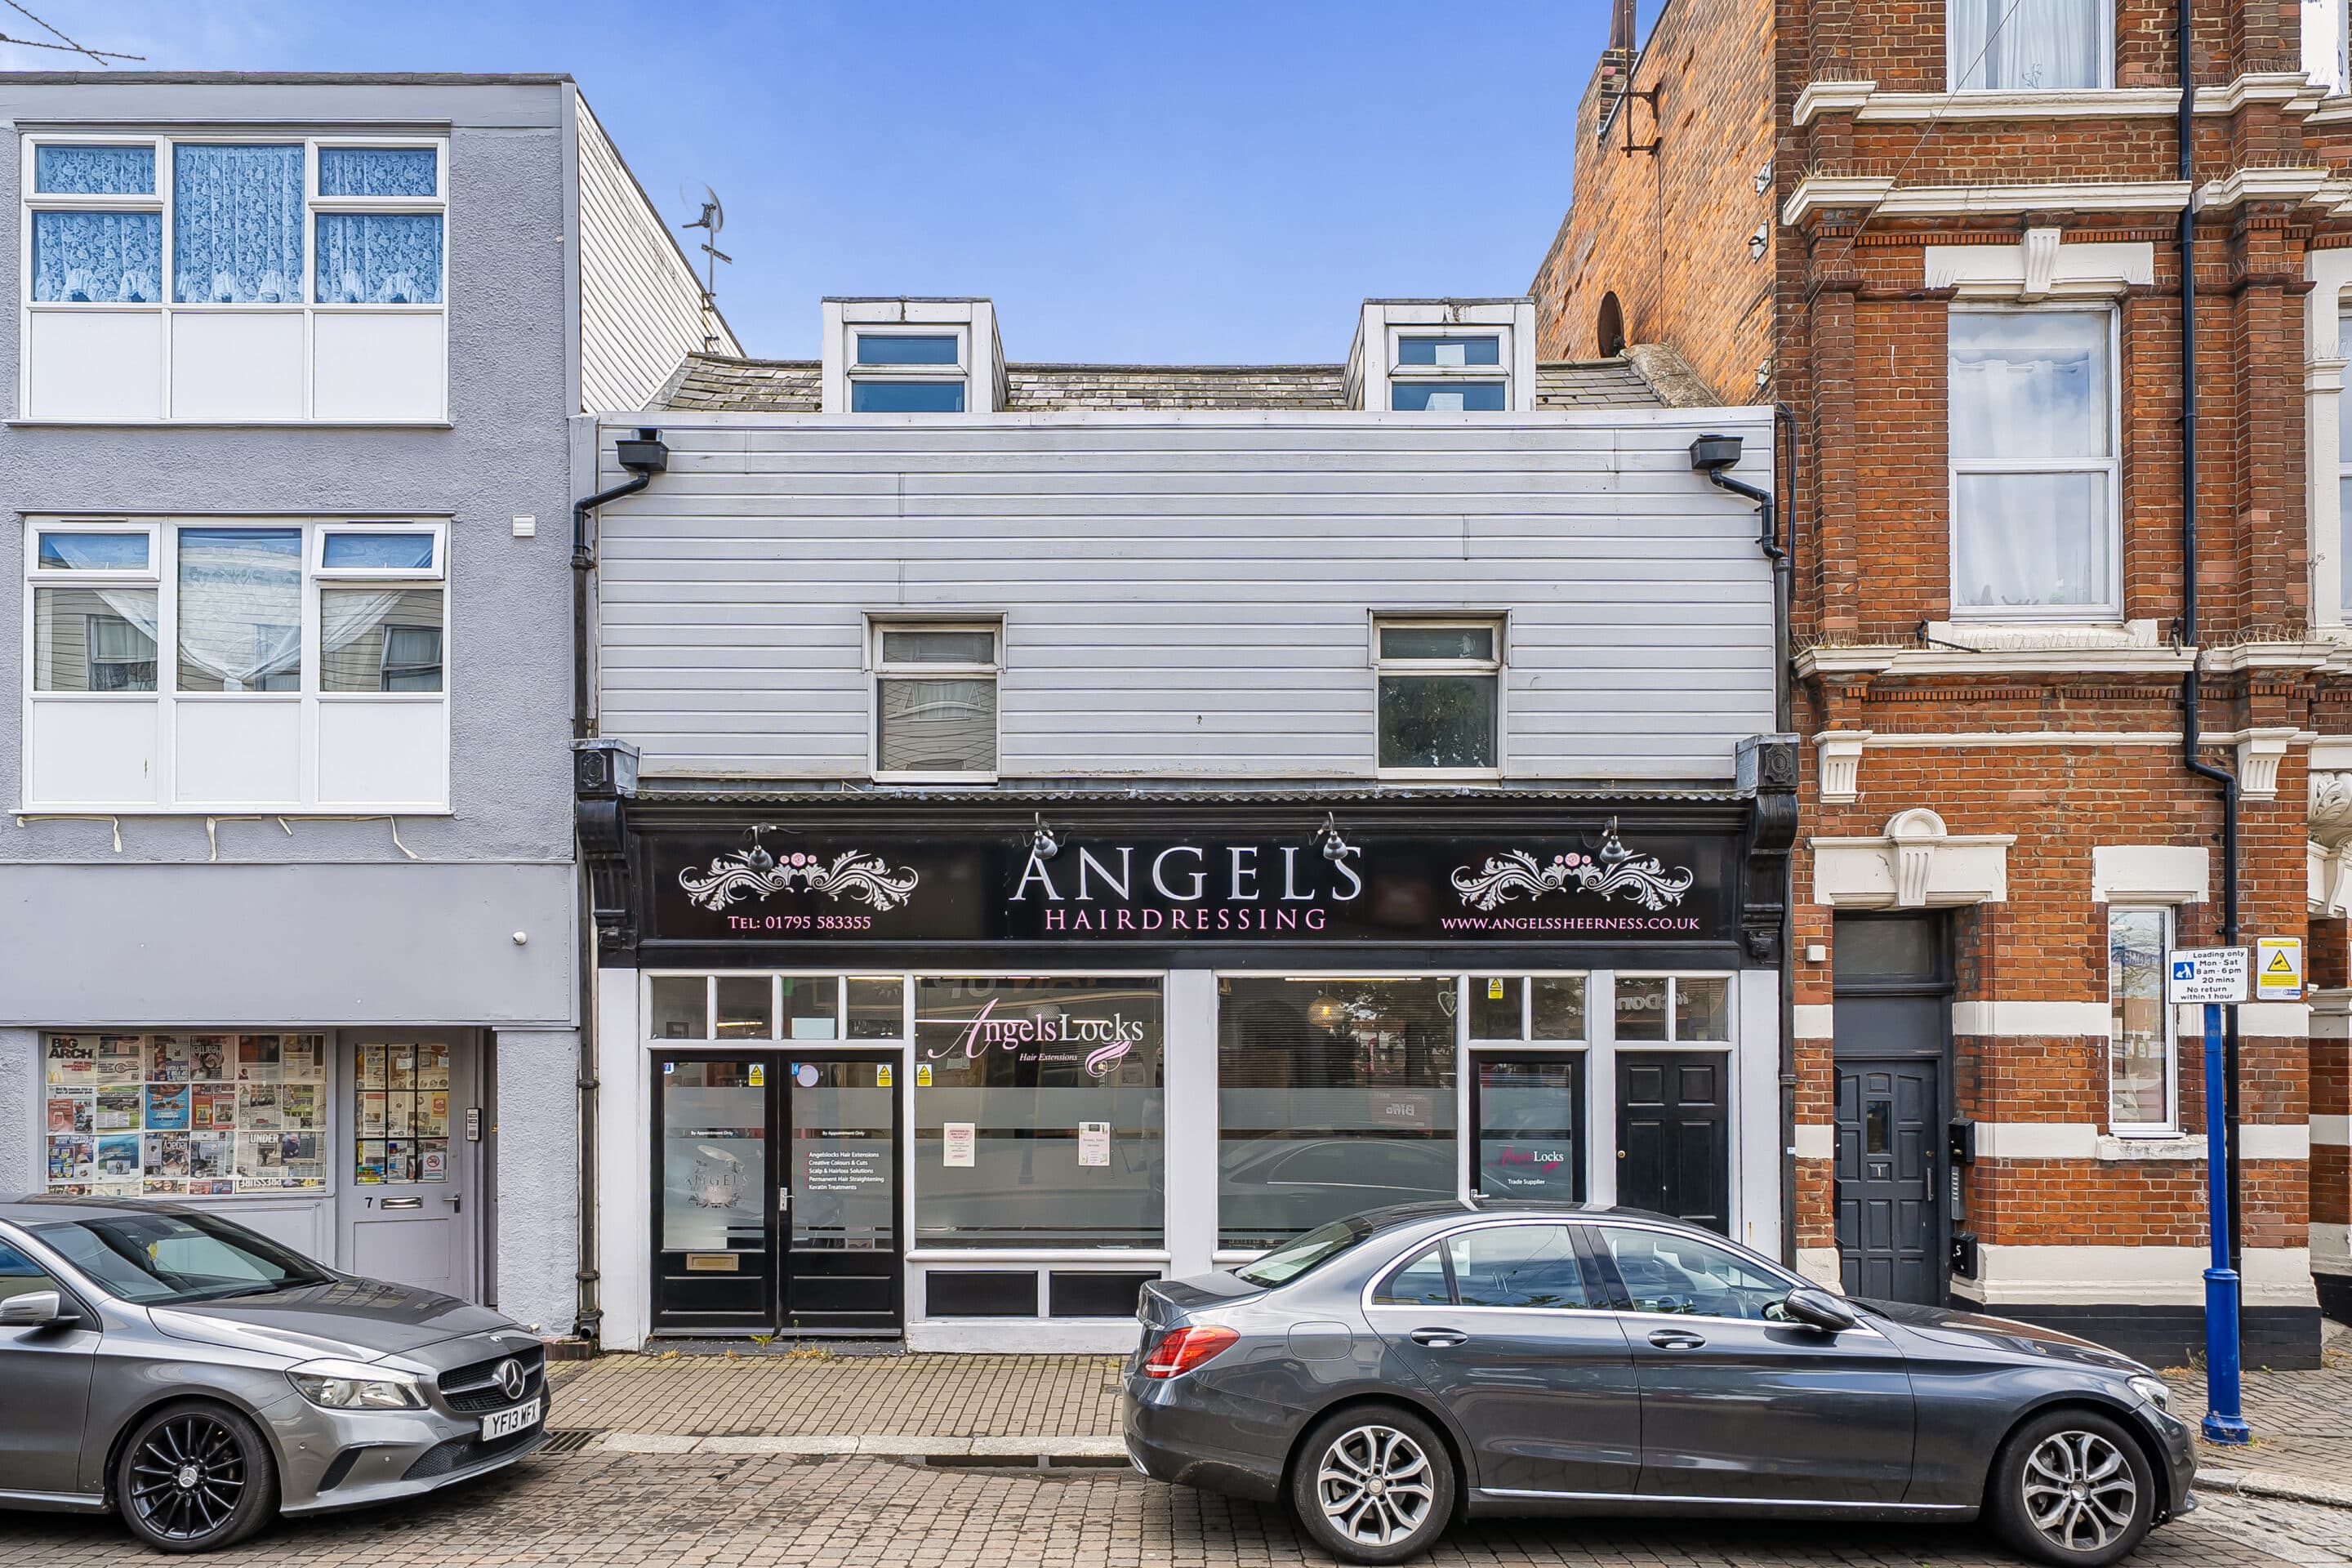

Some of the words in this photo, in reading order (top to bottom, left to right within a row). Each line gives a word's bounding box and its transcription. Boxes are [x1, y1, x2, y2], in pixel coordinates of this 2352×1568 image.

[1009, 846, 1362, 900] ANGELS
[765, 916, 812, 929] 01795
[817, 915, 871, 929] 583355
[1045, 909, 1327, 930] HAIRDRESSING
[928, 998, 1143, 1058] AngelsLocks
[51, 1038, 78, 1049] BIG
[48, 1049, 93, 1059] ARCH
[1019, 1053, 1037, 1062] Hair
[1039, 1053, 1078, 1062] Extensions
[250, 1134, 279, 1143] UNDER
[365, 1197, 373, 1208] 7
[492, 1410, 519, 1435] YF13
